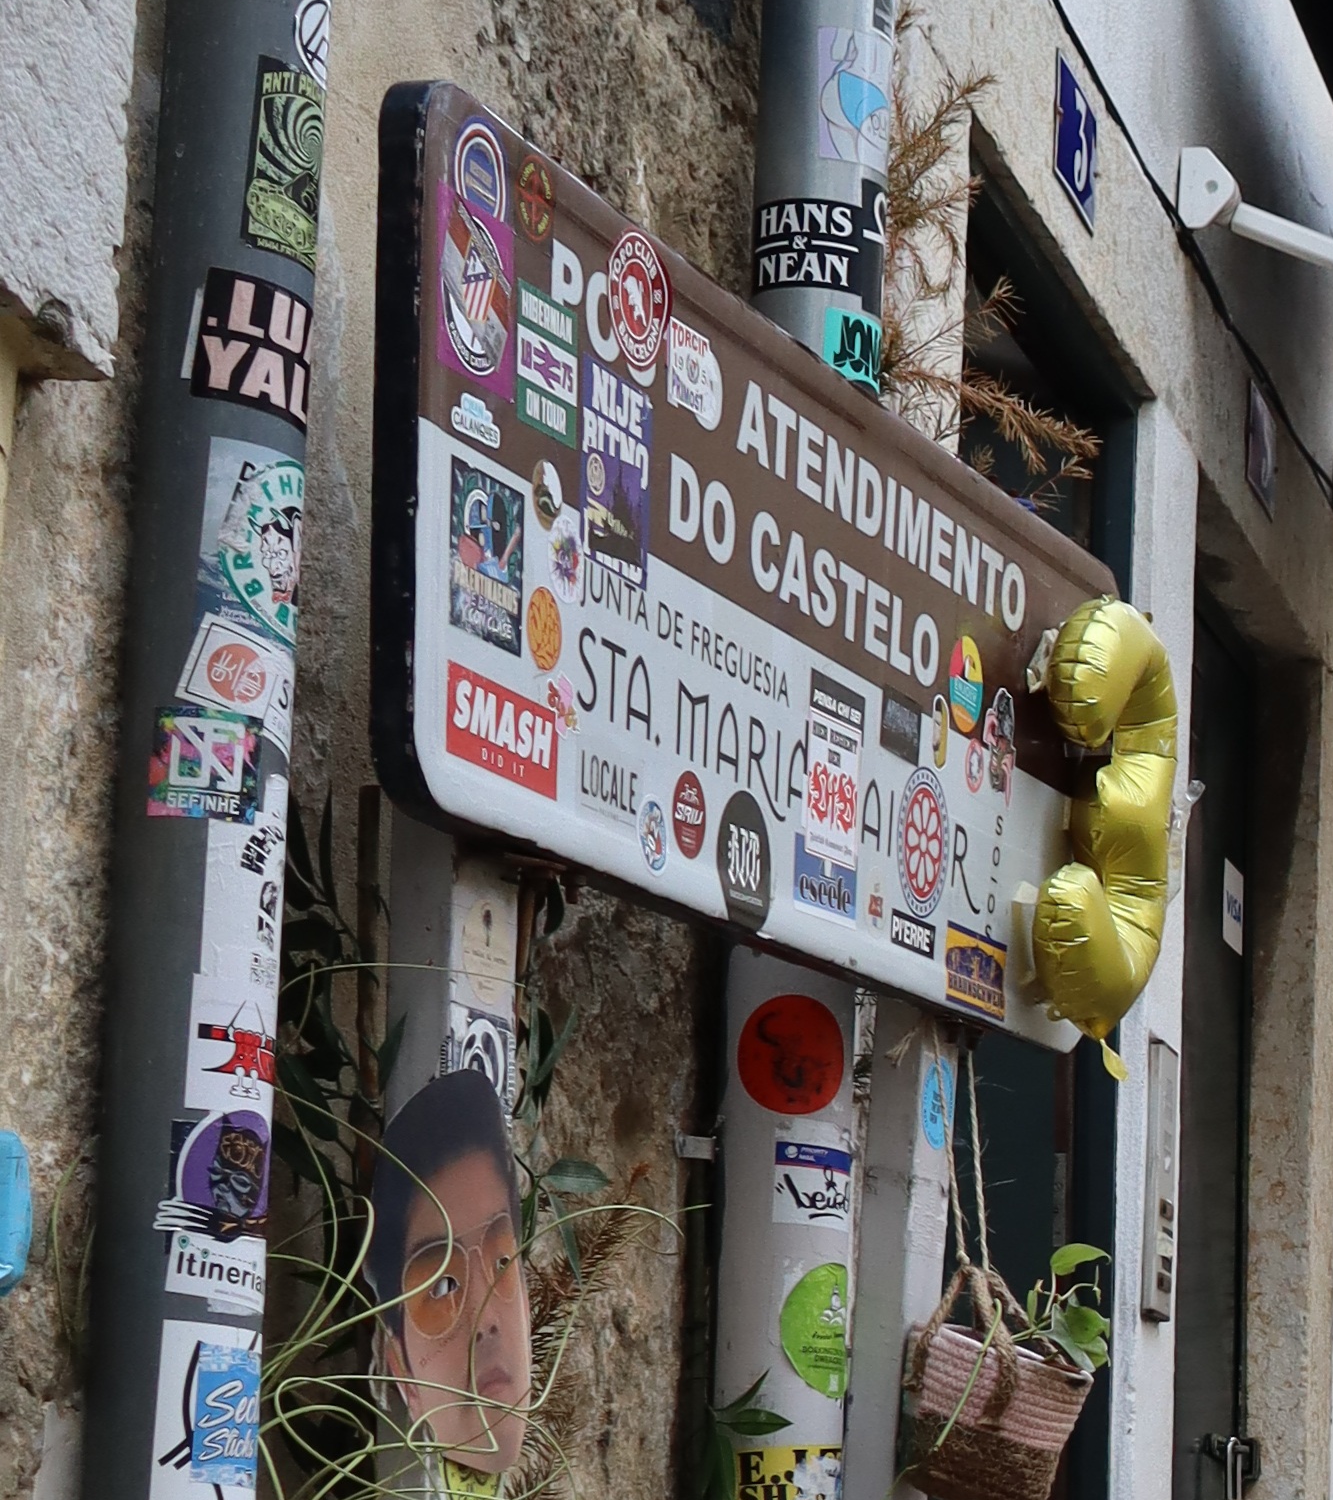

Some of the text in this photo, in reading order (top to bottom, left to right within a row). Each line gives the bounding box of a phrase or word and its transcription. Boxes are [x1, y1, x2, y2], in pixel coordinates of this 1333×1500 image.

[760, 202, 854, 240] HANS
[791, 234, 809, 250] &
[757, 253, 850, 289] NEAN
[521, 287, 574, 346] HIBERNIAN
[540, 393, 568, 437] TOUR
[591, 361, 648, 441] NIJE
[737, 378, 1028, 633] ATENDIMENTO
[668, 451, 736, 566] DO
[750, 500, 941, 690] CASTELO
[579, 558, 790, 708] JUNTA DE FREGUESIA
[453, 679, 556, 769] SMASH
[482, 746, 526, 779] DID IT
[580, 749, 638, 816] LOCALE
[1225, 887, 1243, 927] VISA
